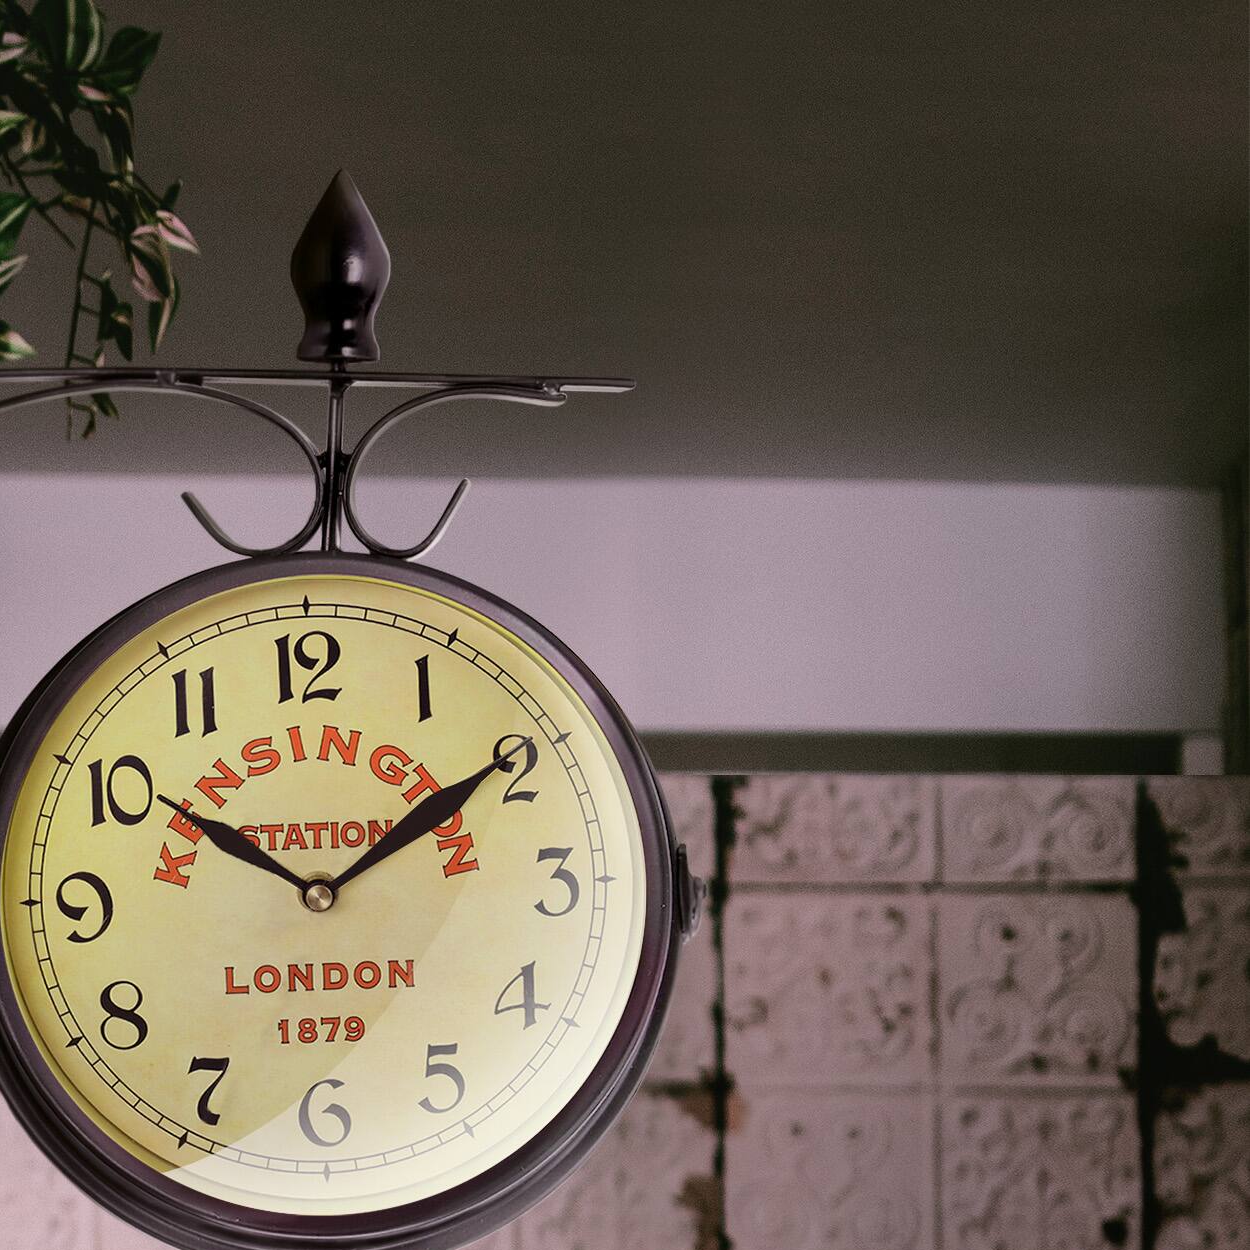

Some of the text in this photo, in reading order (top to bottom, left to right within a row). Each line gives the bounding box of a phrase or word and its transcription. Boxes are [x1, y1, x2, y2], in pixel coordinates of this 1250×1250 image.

[172, 666, 216, 738] 11
[273, 631, 342, 704] 12
[414, 654, 433, 723] 1
[88, 755, 154, 827] 10
[492, 734, 540, 805] 2
[237, 819, 393, 851] STATION
[56, 871, 113, 943] 9
[533, 847, 580, 917] 3
[224, 959, 416, 996] LONDON
[494, 960, 552, 1030] 4
[99, 980, 149, 1050] 8
[277, 1015, 366, 1045] 1879
[187, 1056, 230, 1126] 7
[298, 1078, 353, 1147] 6
[418, 1042, 466, 1114] 5
